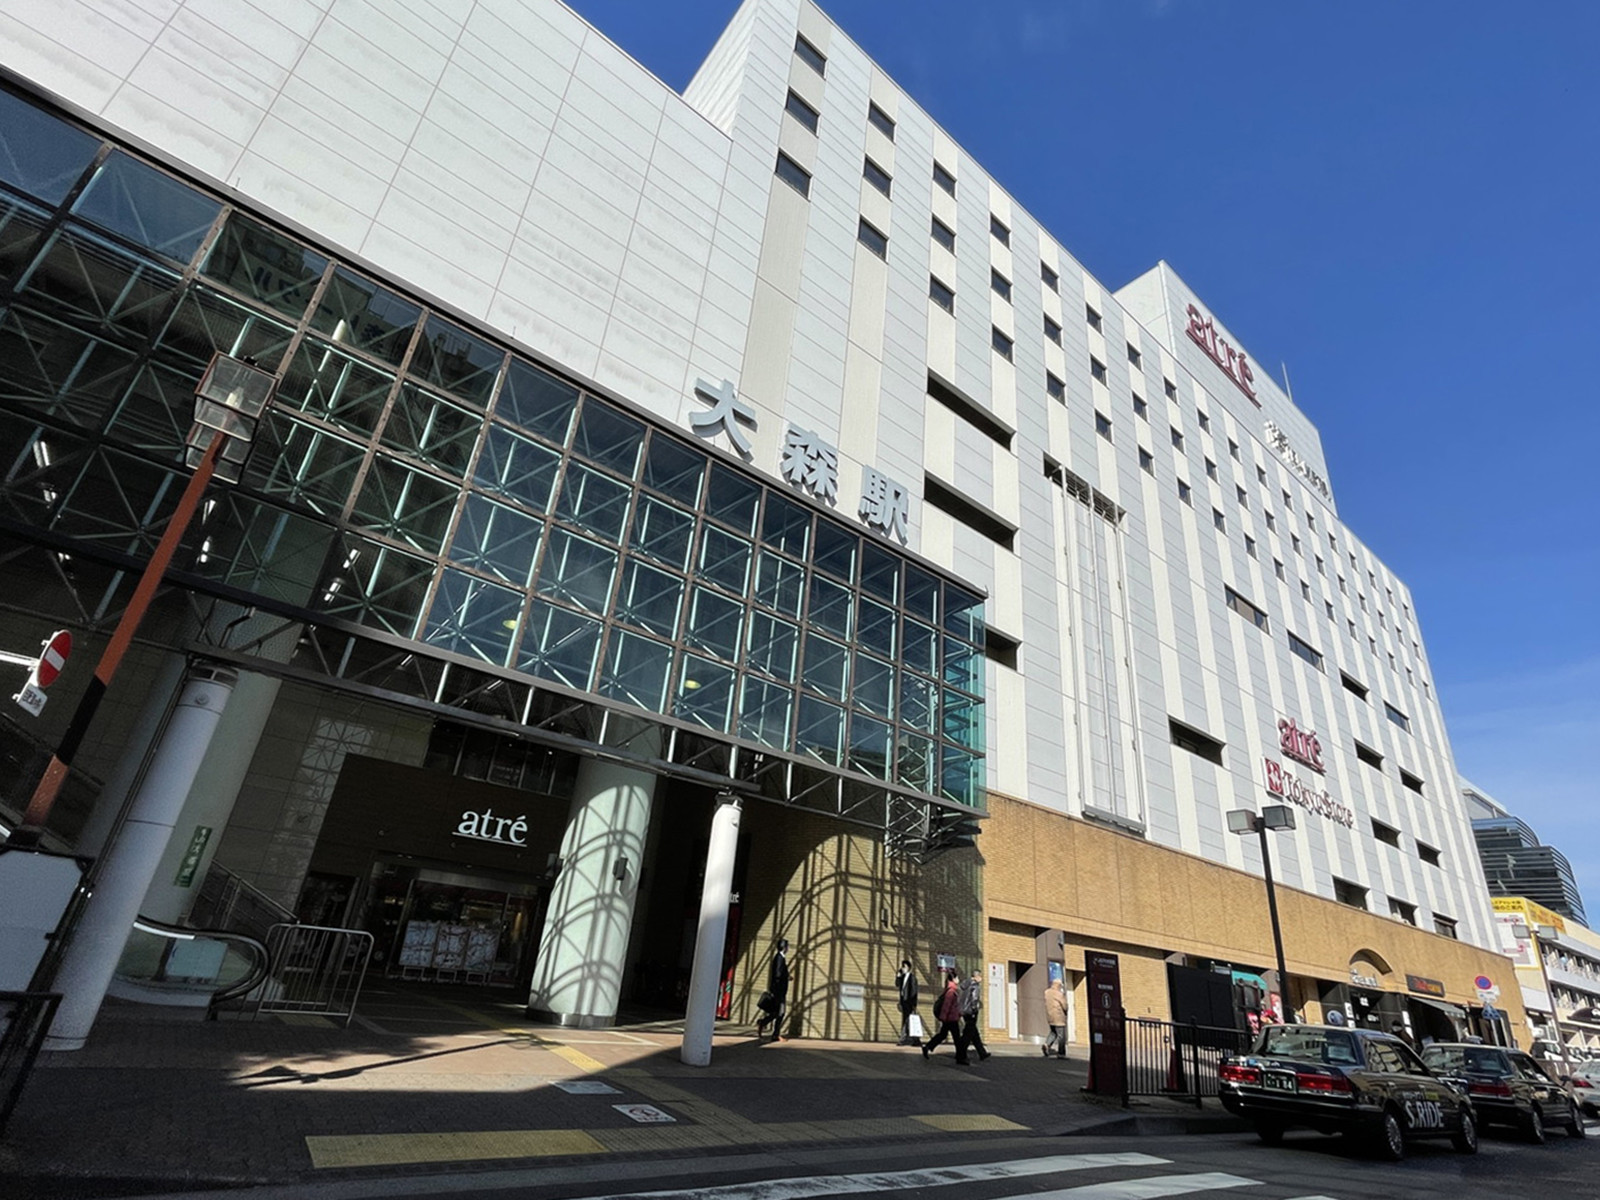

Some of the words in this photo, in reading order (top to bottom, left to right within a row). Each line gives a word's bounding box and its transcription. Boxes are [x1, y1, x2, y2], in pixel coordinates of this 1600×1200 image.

[1185, 303, 1259, 402] atré
[688, 377, 908, 547] 大森駅
[1278, 717, 1325, 772] atré
[457, 808, 528, 845] atré
[729, 891, 740, 904] tré
